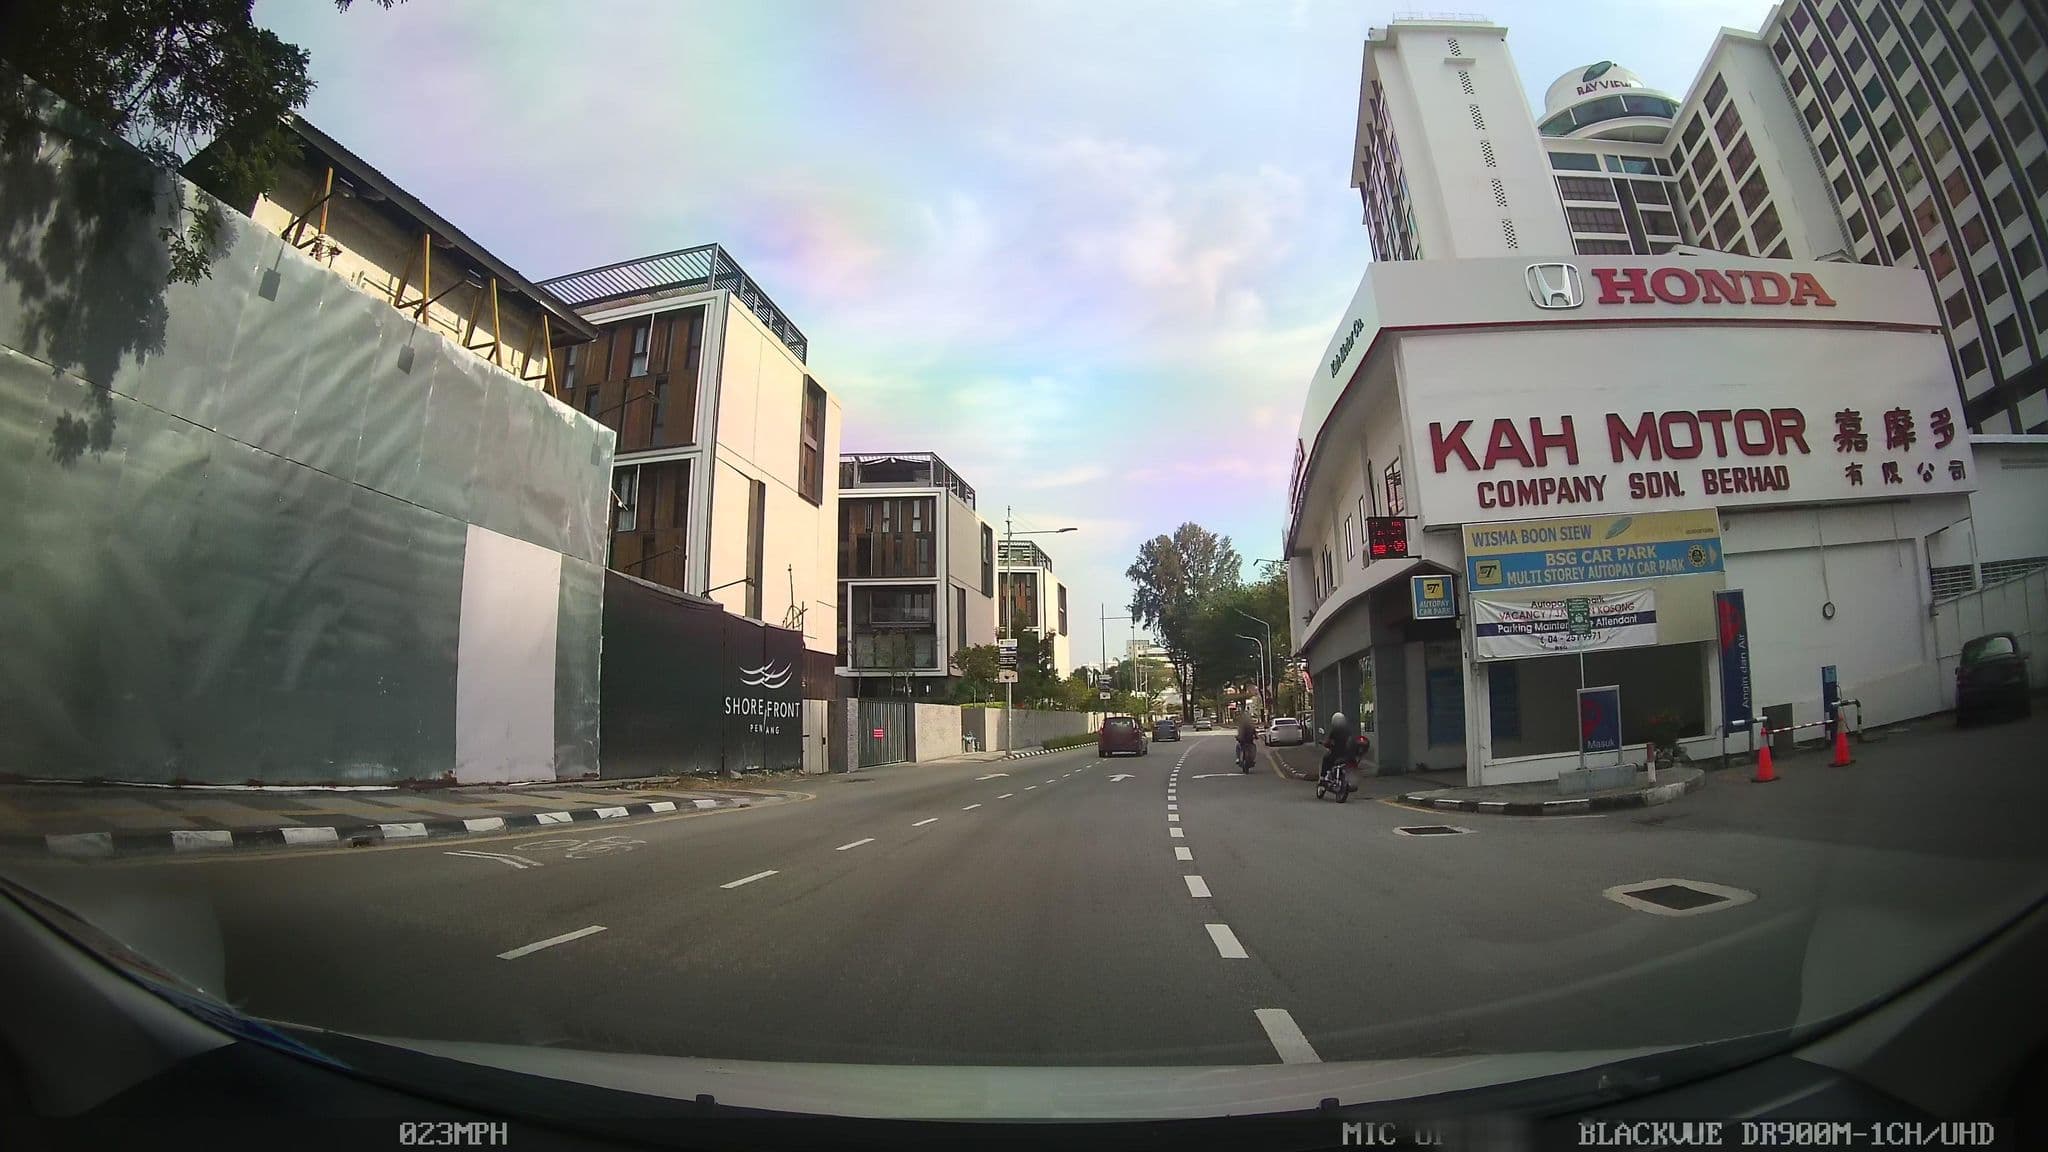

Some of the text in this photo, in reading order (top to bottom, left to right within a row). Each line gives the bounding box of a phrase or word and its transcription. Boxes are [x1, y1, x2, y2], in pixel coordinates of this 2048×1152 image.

[1592, 267, 1836, 307] HONDA
[1429, 408, 1811, 474] KAH MOTOR
[1833, 406, 1955, 453] 嘉摩多
[1845, 459, 1966, 486] 有限公司
[1477, 465, 1790, 509] COMPANY SDN. BERHAD
[1472, 524, 1592, 547] WISMA BOON SIEW
[1546, 545, 1658, 565] BSG CAR PARK
[1507, 570, 1541, 585] MULTI
[1544, 566, 1585, 583] STOREY
[1588, 562, 1635, 579] AUTOPAY
[1638, 560, 1656, 575] CAR
[1659, 557, 1685, 573] PARK
[1600, 602, 1635, 614] KOSONG
[1498, 622, 1532, 635] Parking
